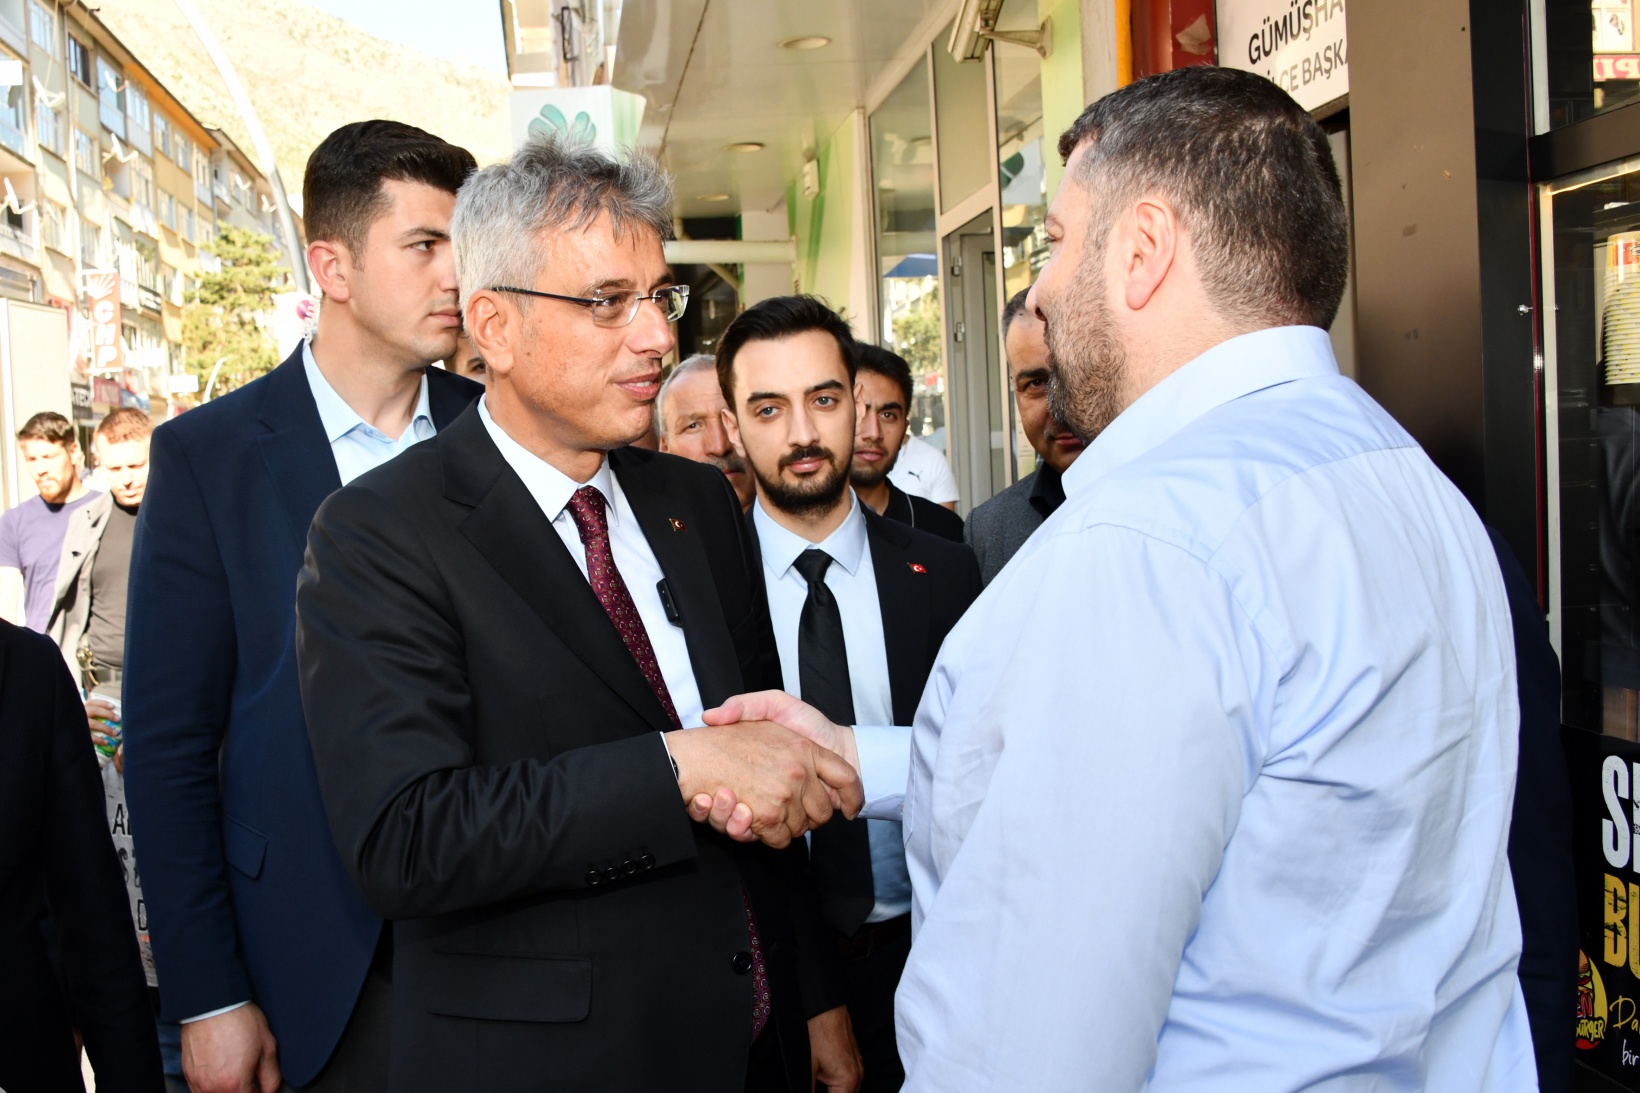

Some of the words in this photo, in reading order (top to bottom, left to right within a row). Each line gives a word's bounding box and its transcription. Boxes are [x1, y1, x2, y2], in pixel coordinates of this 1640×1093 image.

[1302, 38, 1349, 86] BAŞK
[94, 300, 118, 368] CHP
[1609, 994, 1640, 1035] Da
